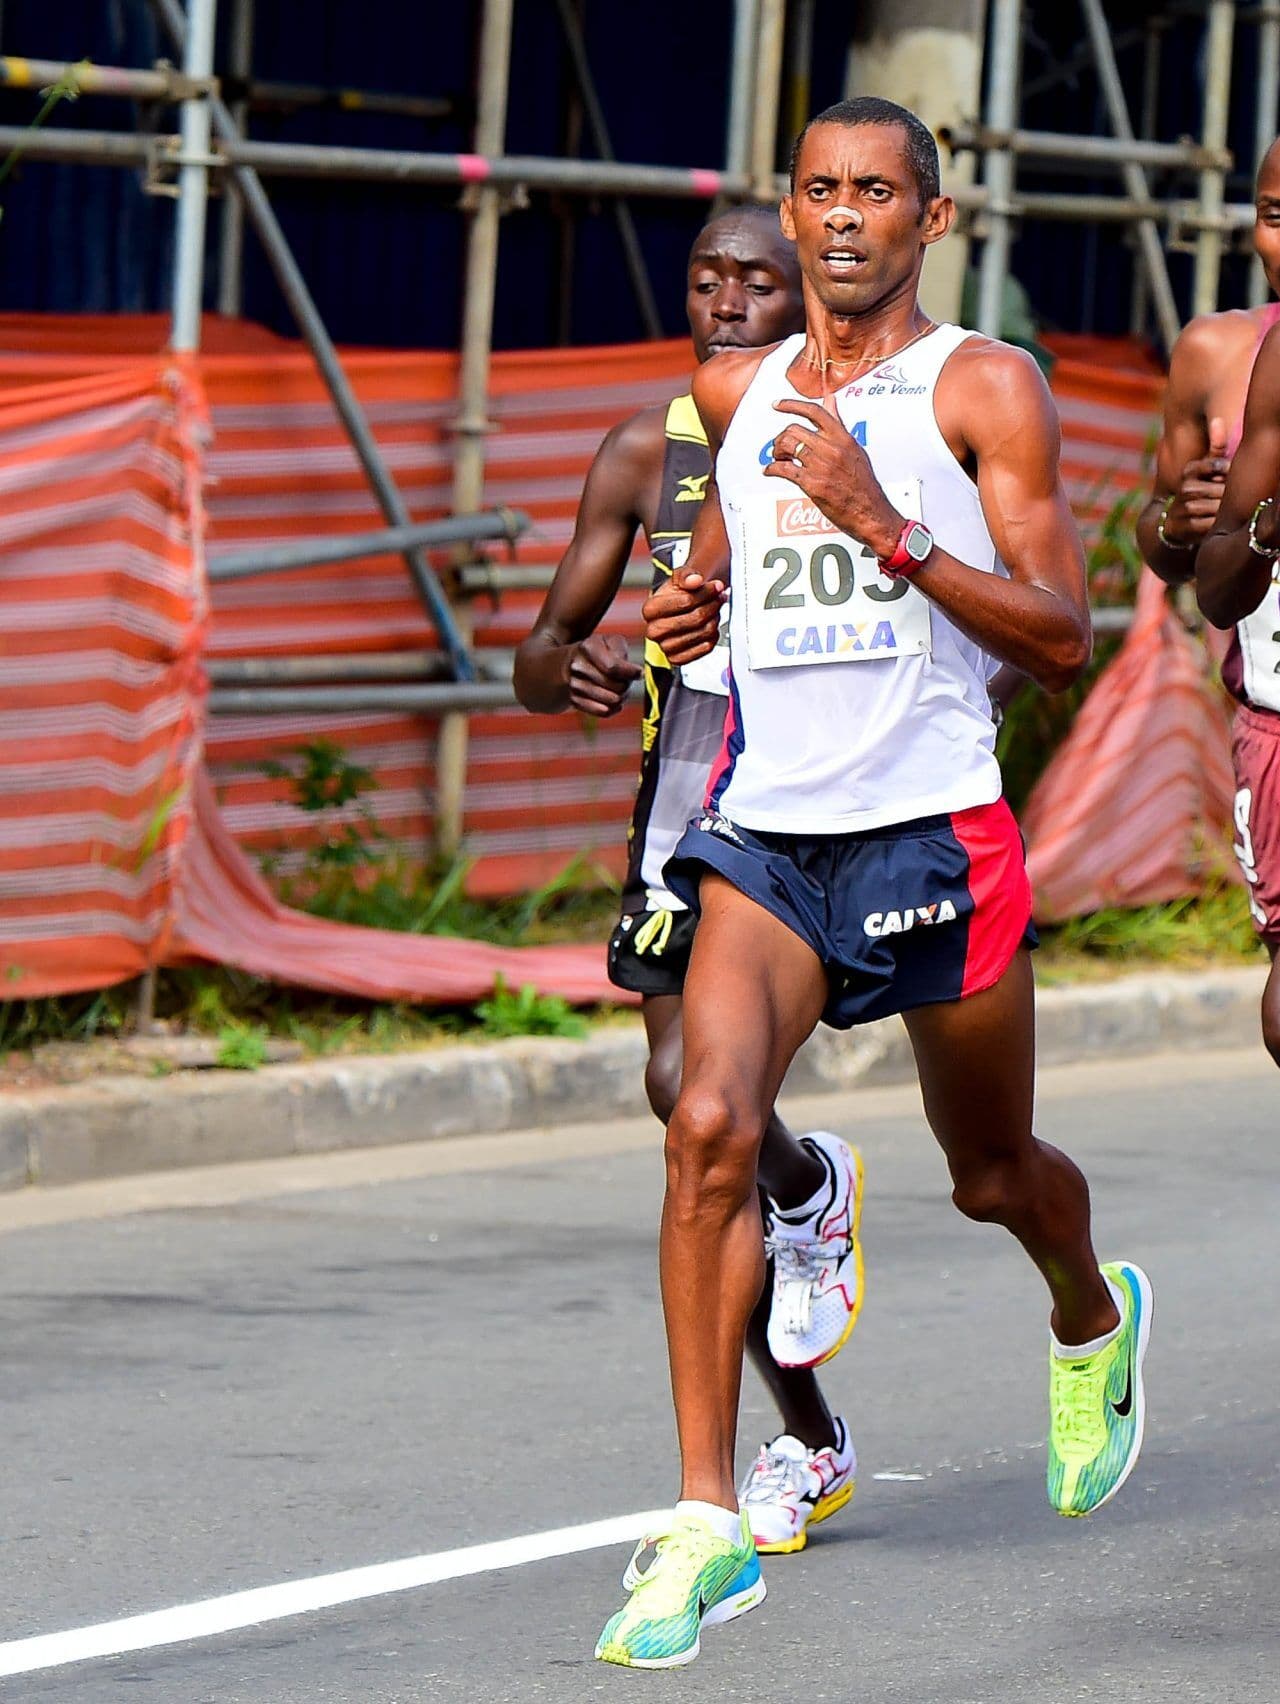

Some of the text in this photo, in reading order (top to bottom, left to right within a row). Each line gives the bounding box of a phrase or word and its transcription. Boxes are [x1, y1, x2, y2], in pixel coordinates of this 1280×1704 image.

[868, 383, 886, 395] de
[776, 620, 897, 656] CAIXA
[863, 899, 957, 937] CAIXA
